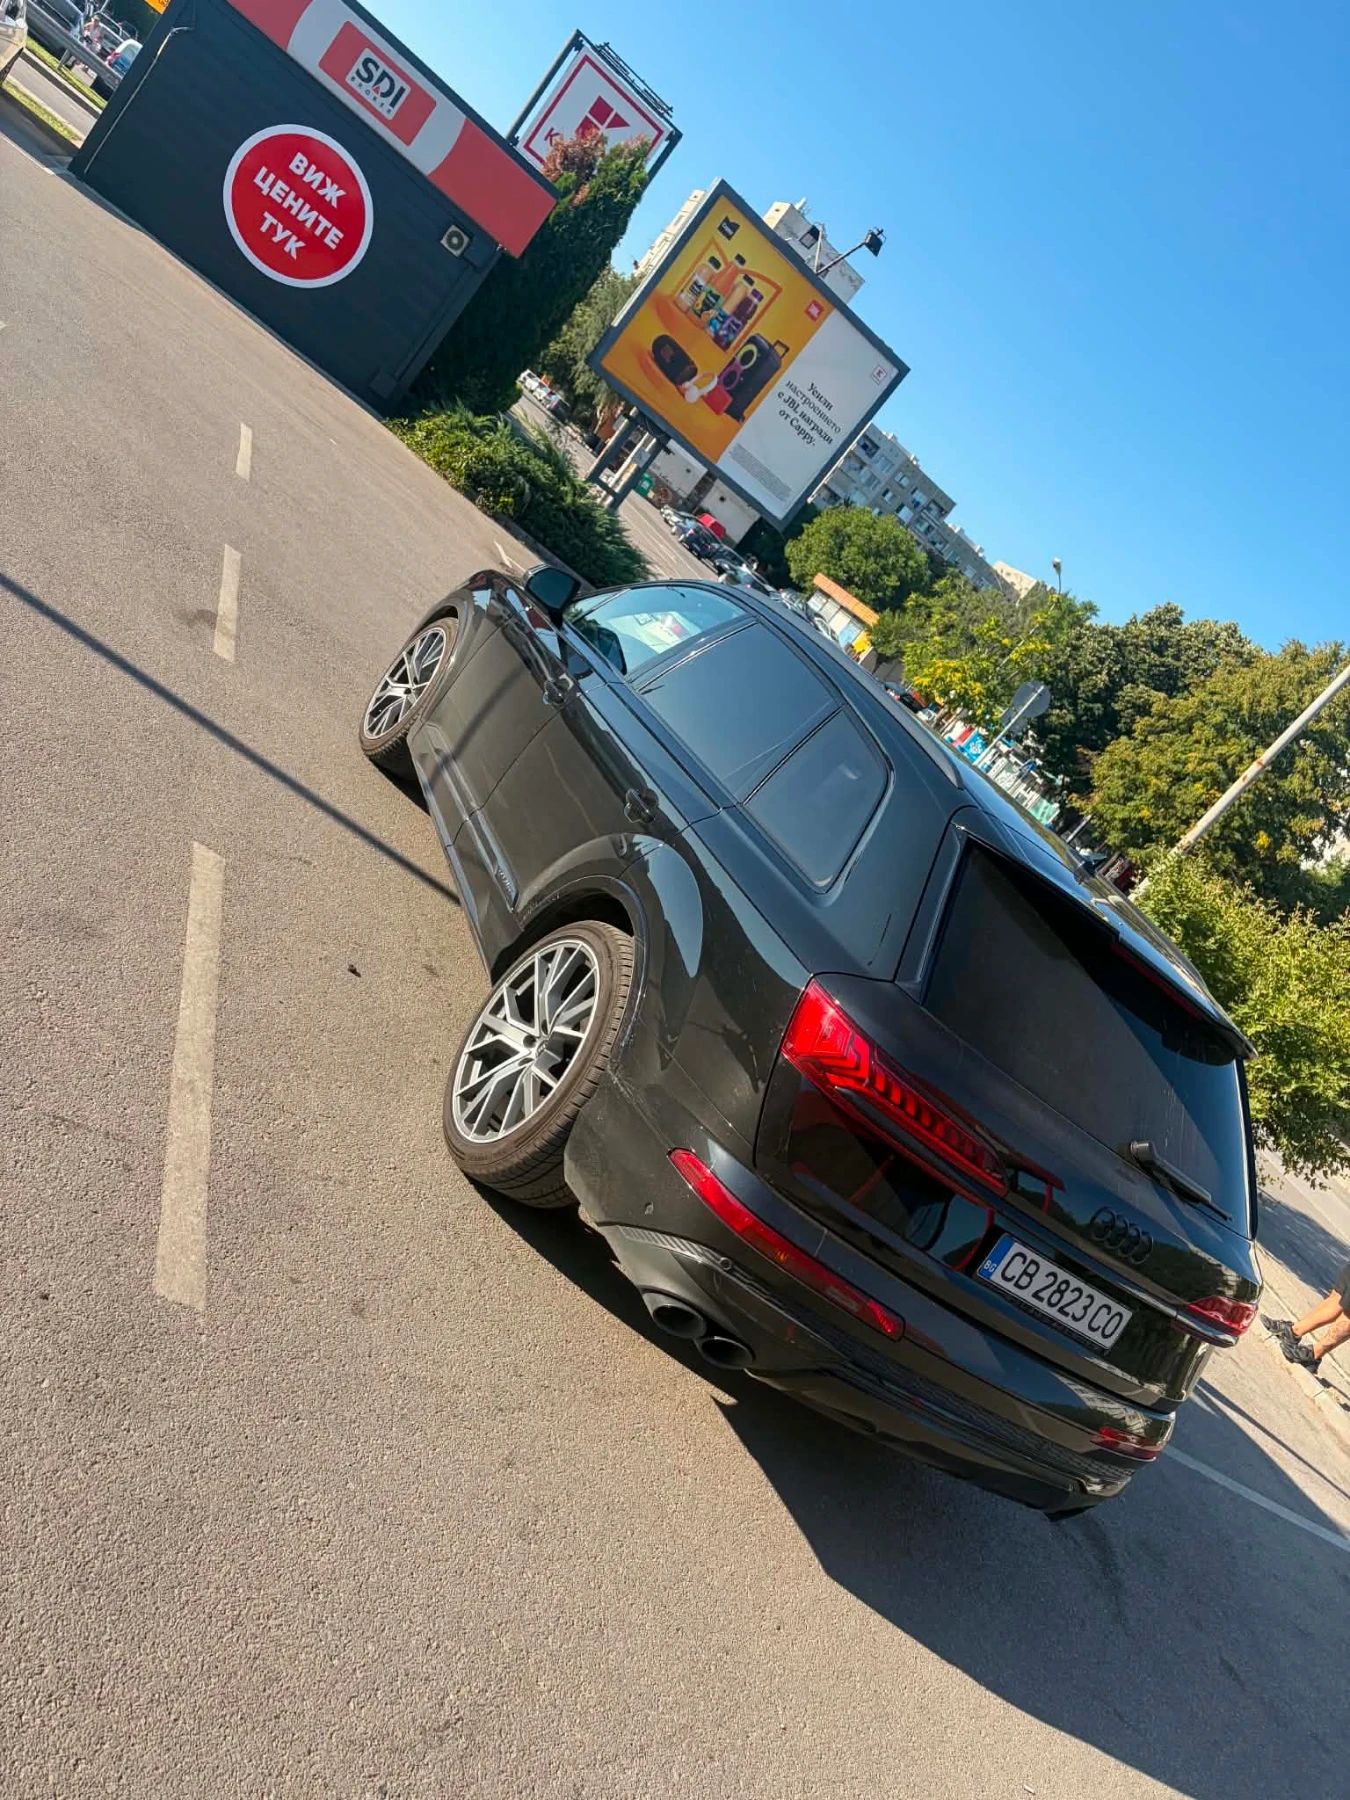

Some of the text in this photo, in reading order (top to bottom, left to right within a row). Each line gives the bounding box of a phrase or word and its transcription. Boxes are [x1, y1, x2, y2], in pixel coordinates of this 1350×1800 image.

[355, 57, 406, 109] SDI
[289, 151, 347, 209] ВИЖ
[253, 166, 344, 250] ЦЕНИТЕ
[260, 211, 306, 260] ТУК
[778, 409, 790, 421] от
[783, 395, 800, 415] JBL
[799, 411, 834, 446] награди
[785, 380, 841, 434] настроението
[807, 382, 834, 412] Усили
[983, 1259, 997, 1273] BG
[1000, 1251, 1041, 1290] CB
[1031, 1271, 1095, 1323] 2823
[1087, 1303, 1124, 1339] CO
